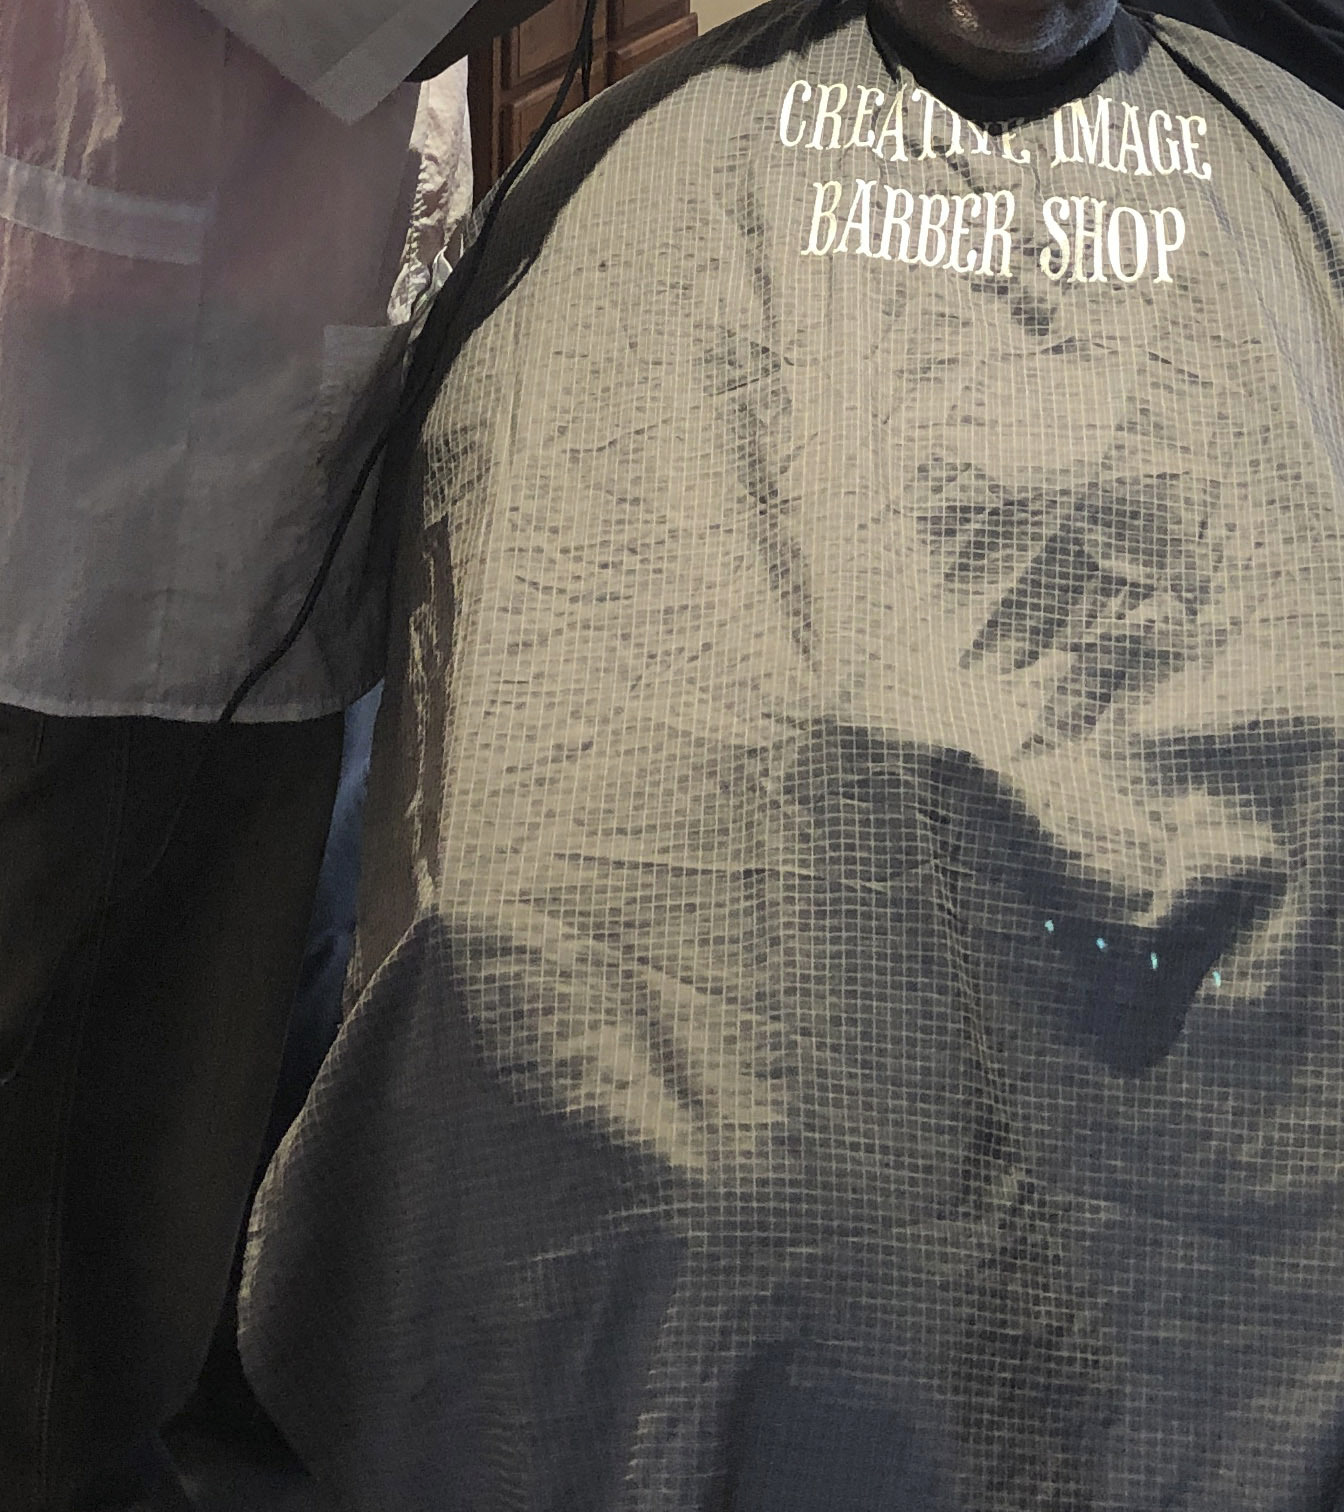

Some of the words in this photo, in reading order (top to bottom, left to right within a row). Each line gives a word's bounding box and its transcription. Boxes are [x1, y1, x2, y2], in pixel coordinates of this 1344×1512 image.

[779, 78, 1031, 165] CREATIVE
[1050, 94, 1213, 181] IMAGE
[800, 178, 1016, 279] BARBER
[1038, 195, 1187, 285] SHOP
